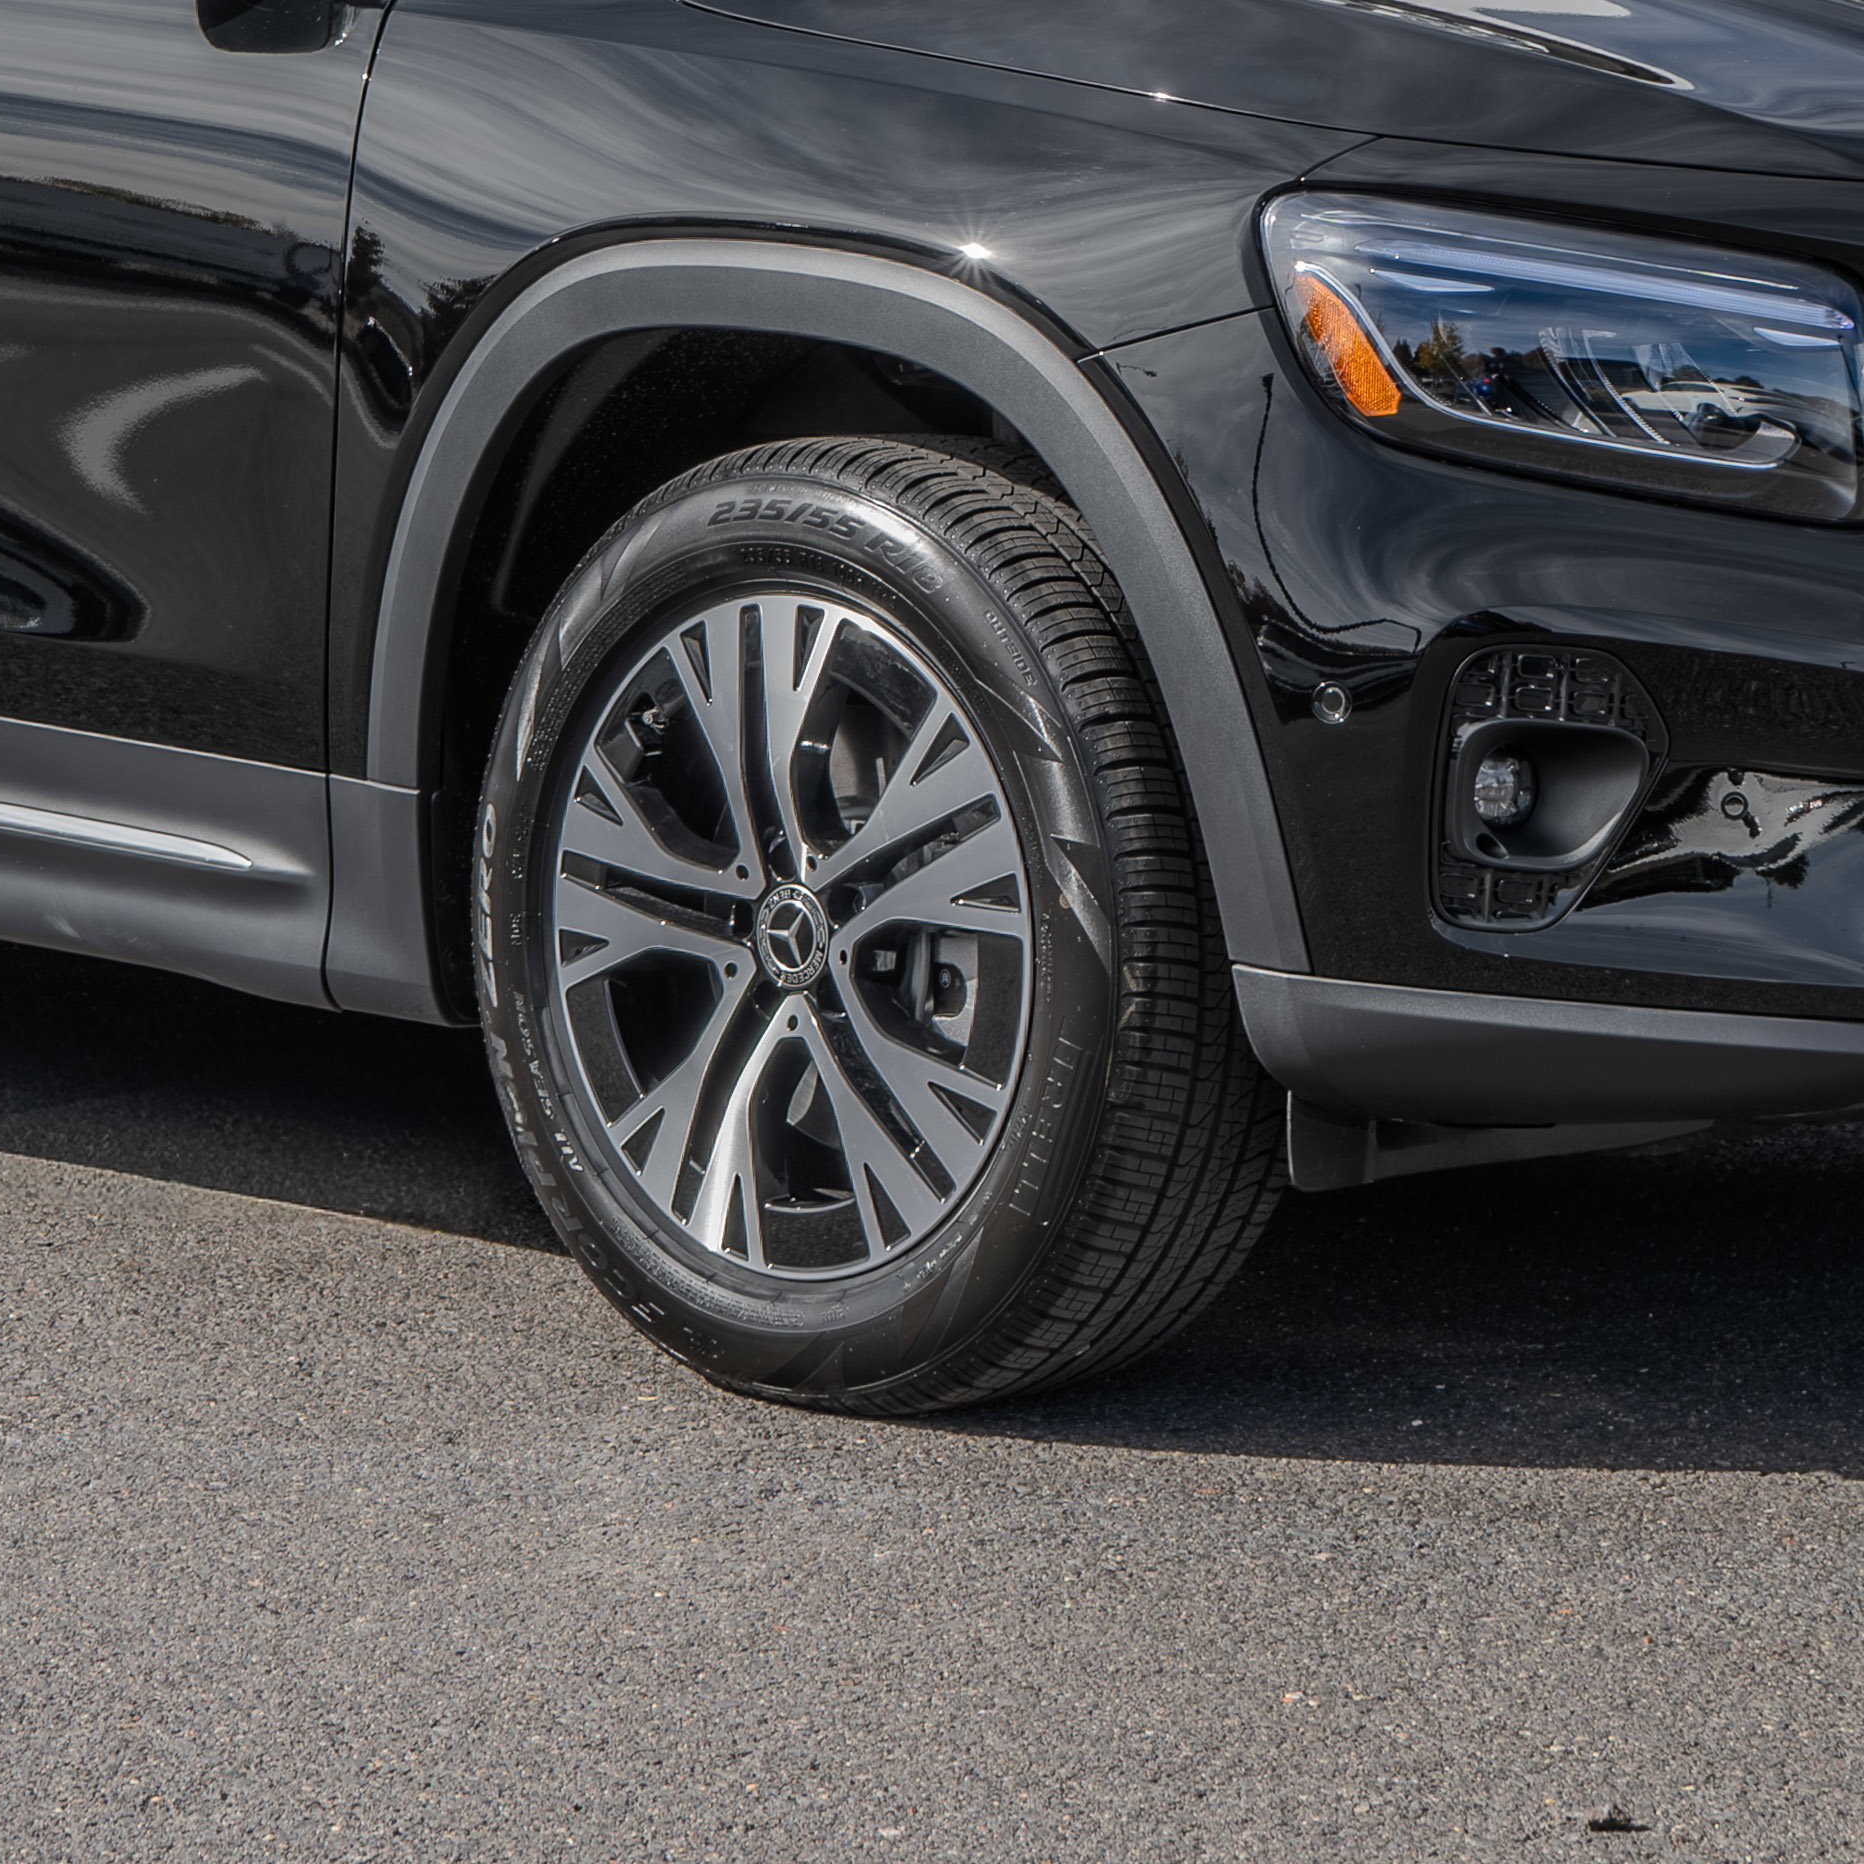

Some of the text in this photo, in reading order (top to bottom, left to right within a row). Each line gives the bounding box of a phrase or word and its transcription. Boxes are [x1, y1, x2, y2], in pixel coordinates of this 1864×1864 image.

[706, 497, 944, 596] 235/55 R18
[982, 609, 1039, 687] OUTSIDE
[476, 801, 499, 1009] ZERO
[511, 989, 557, 1120] SEASON
